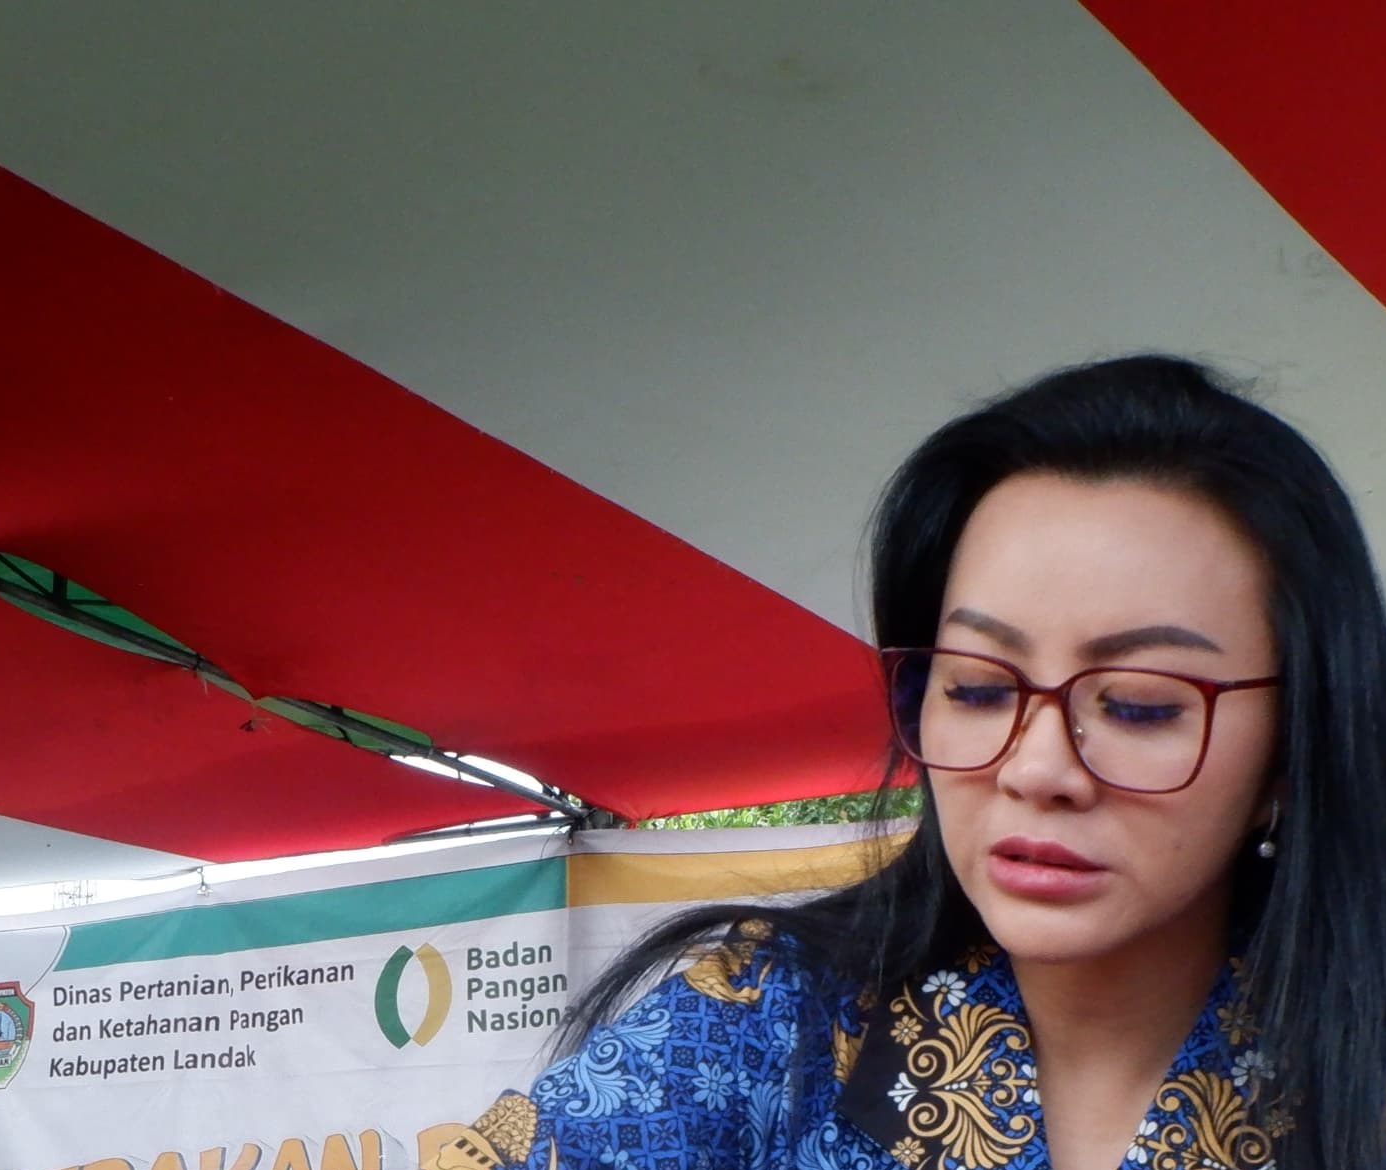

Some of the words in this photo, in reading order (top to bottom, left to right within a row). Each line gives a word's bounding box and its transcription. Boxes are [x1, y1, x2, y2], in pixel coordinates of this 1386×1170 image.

[466, 941, 552, 970] Badan
[53, 985, 112, 1007] Dinas
[120, 974, 235, 1002] Pertanian,
[240, 964, 355, 991] Perikanan
[467, 973, 567, 1002] Pangan
[53, 1021, 92, 1042] dan
[99, 1014, 221, 1040] Ketahanan
[229, 1007, 304, 1032] Pangan
[49, 1054, 165, 1079] Kabupaten
[173, 1044, 256, 1070] Landak
